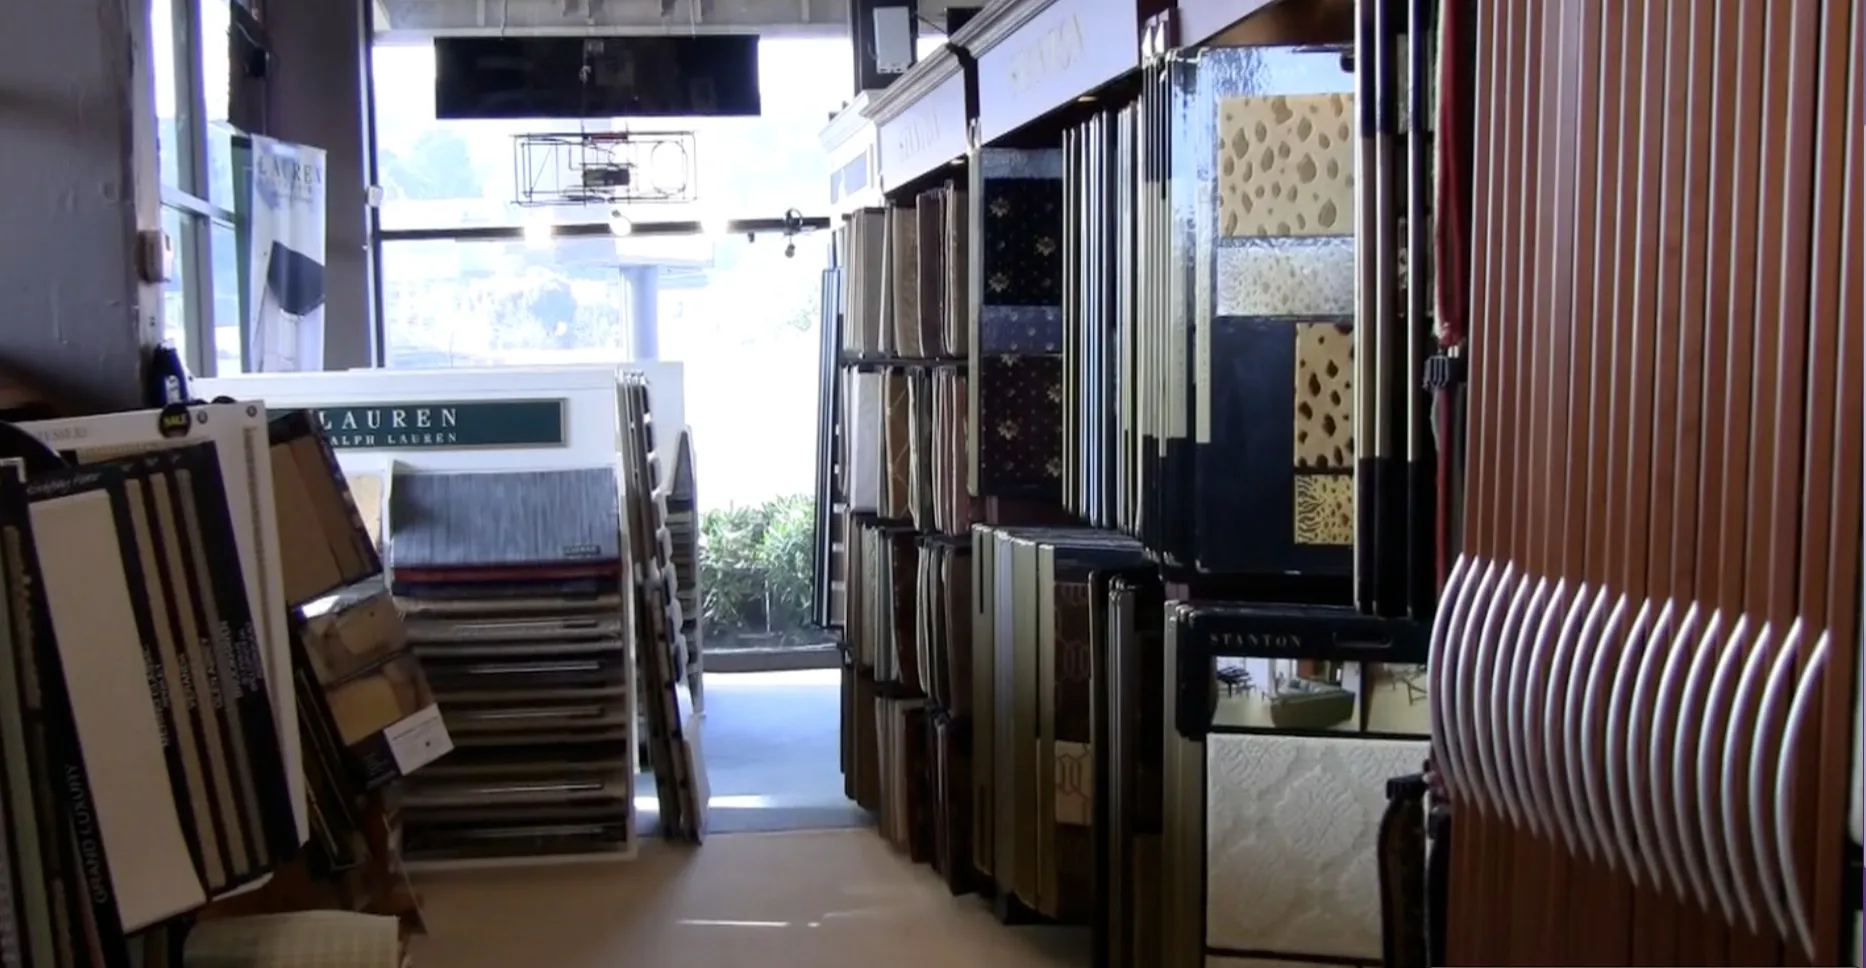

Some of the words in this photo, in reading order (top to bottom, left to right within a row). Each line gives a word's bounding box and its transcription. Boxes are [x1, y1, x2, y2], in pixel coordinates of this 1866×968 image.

[318, 408, 457, 430] LAUREN
[330, 434, 375, 446] ALPH
[387, 432, 457, 445] LAUREN
[1209, 632, 1301, 647] STANTON
